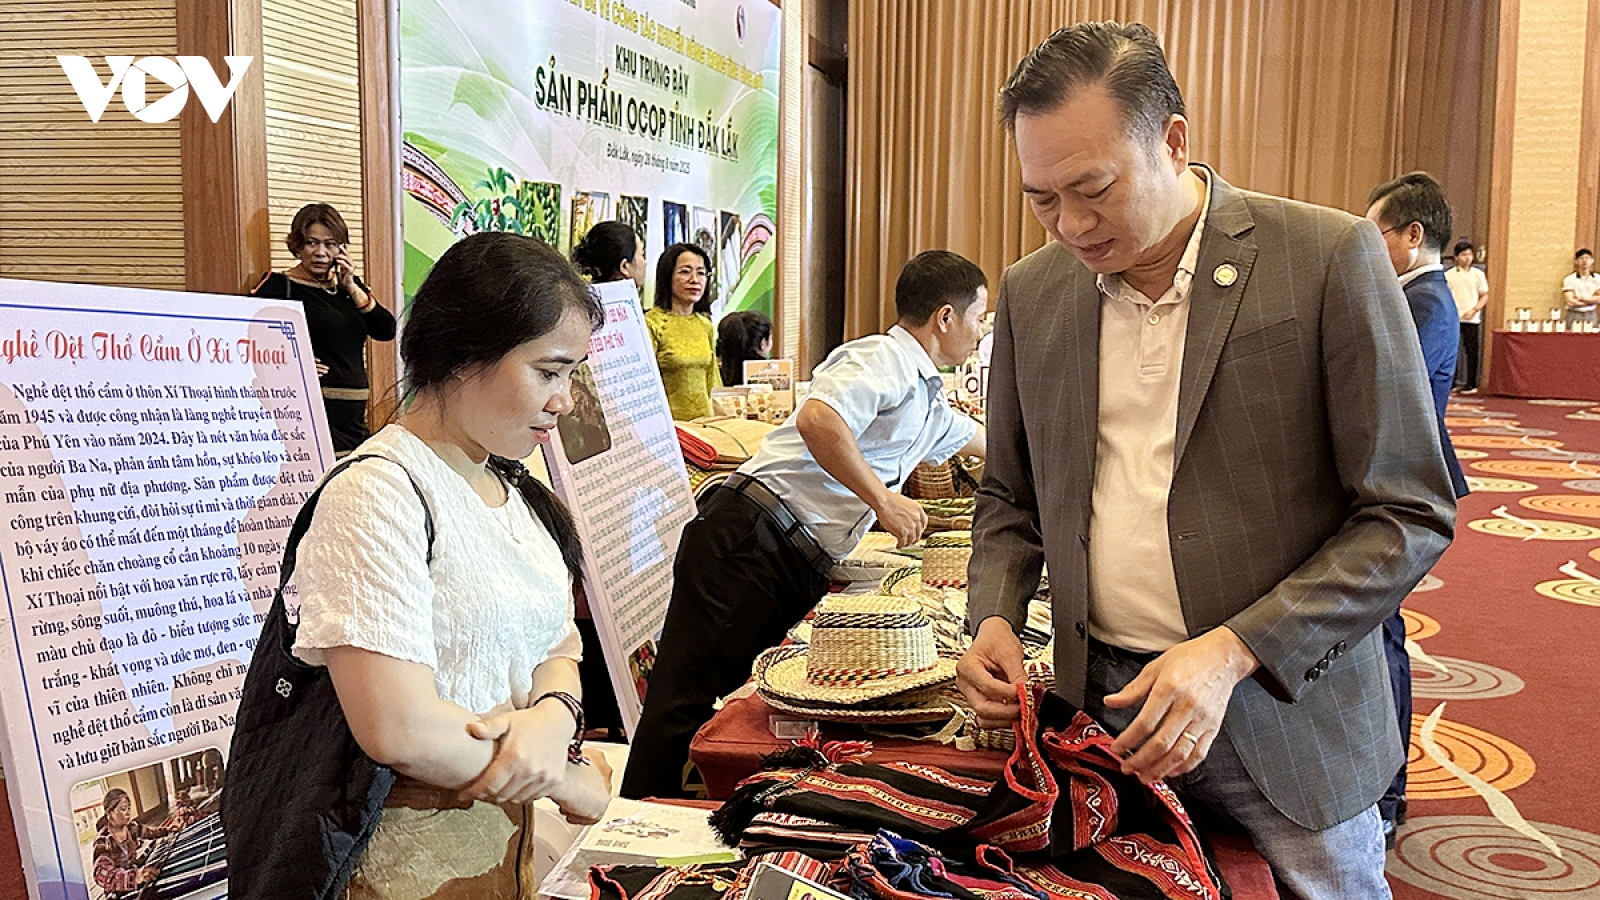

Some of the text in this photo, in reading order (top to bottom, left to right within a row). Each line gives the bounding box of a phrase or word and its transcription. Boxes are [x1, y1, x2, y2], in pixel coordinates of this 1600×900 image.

[612, 0, 638, 33] CÔNG
[640, 12, 656, 41] TÁC
[616, 44, 637, 76] KHU
[640, 55, 670, 88] TRƯNG
[672, 65, 690, 95] BÀY
[535, 55, 740, 160] SẢN PHẨM OCOP TỈNH ĐẮK LẮK
[0, 329, 41, 364] ghề
[45, 330, 86, 365] Dệt
[92, 332, 132, 360] Thổ
[140, 334, 184, 362] Cẩm
[188, 328, 201, 363] Ở
[236, 339, 288, 369] Thoại
[12, 381, 297, 402] Nghề dệt thổ cẩm thôn Xí Thoại hình thành trước
[24, 405, 302, 426] 1945 và được công nhận là làng nghề truyền thống
[21, 429, 269, 450] Phú Yên vào năm 2024. Đây là nét văn hóa
[0, 450, 278, 479] của người Ba Na, phản ánh tâm sự léo
[5, 472, 277, 504] mẫn của phụ nữ địa phương. Sản phẩm được
[10, 496, 256, 532] công trên khung đòi hỏi và thời
[15, 517, 236, 559] bộ váy áo có thể mất đến một tháng để
[20, 541, 256, 583] khi chiếc chăn choàng khoảng 10
[25, 572, 220, 610] Xí Thoại nổi bật với hoa văn rực
[32, 595, 224, 636] rừng, sông suối, muông thú, hoa
[36, 645, 68, 663] màu
[72, 638, 96, 656] chủ
[100, 637, 123, 654] đạo
[126, 632, 139, 647] là
[142, 628, 157, 644] đỏ
[168, 620, 195, 639] biểu
[197, 620, 231, 635] tượng
[232, 613, 251, 628] sức
[42, 669, 80, 690] trắng
[89, 661, 120, 680] khát
[122, 659, 153, 676] vọng
[154, 652, 169, 667] và
[170, 648, 192, 664] ước
[193, 645, 216, 660] mơ,
[217, 641, 237, 653] đen
[48, 700, 60, 716] vĩ
[65, 695, 90, 712] của
[93, 688, 127, 707] thiên
[131, 680, 169, 698] nhiên.
[173, 671, 213, 689] Không
[215, 662, 234, 679] chỉ
[53, 702, 181, 746] nghề dệt thổ cẩm còn
[58, 714, 236, 770] và lưu giữ bản sắc người Ba Na
